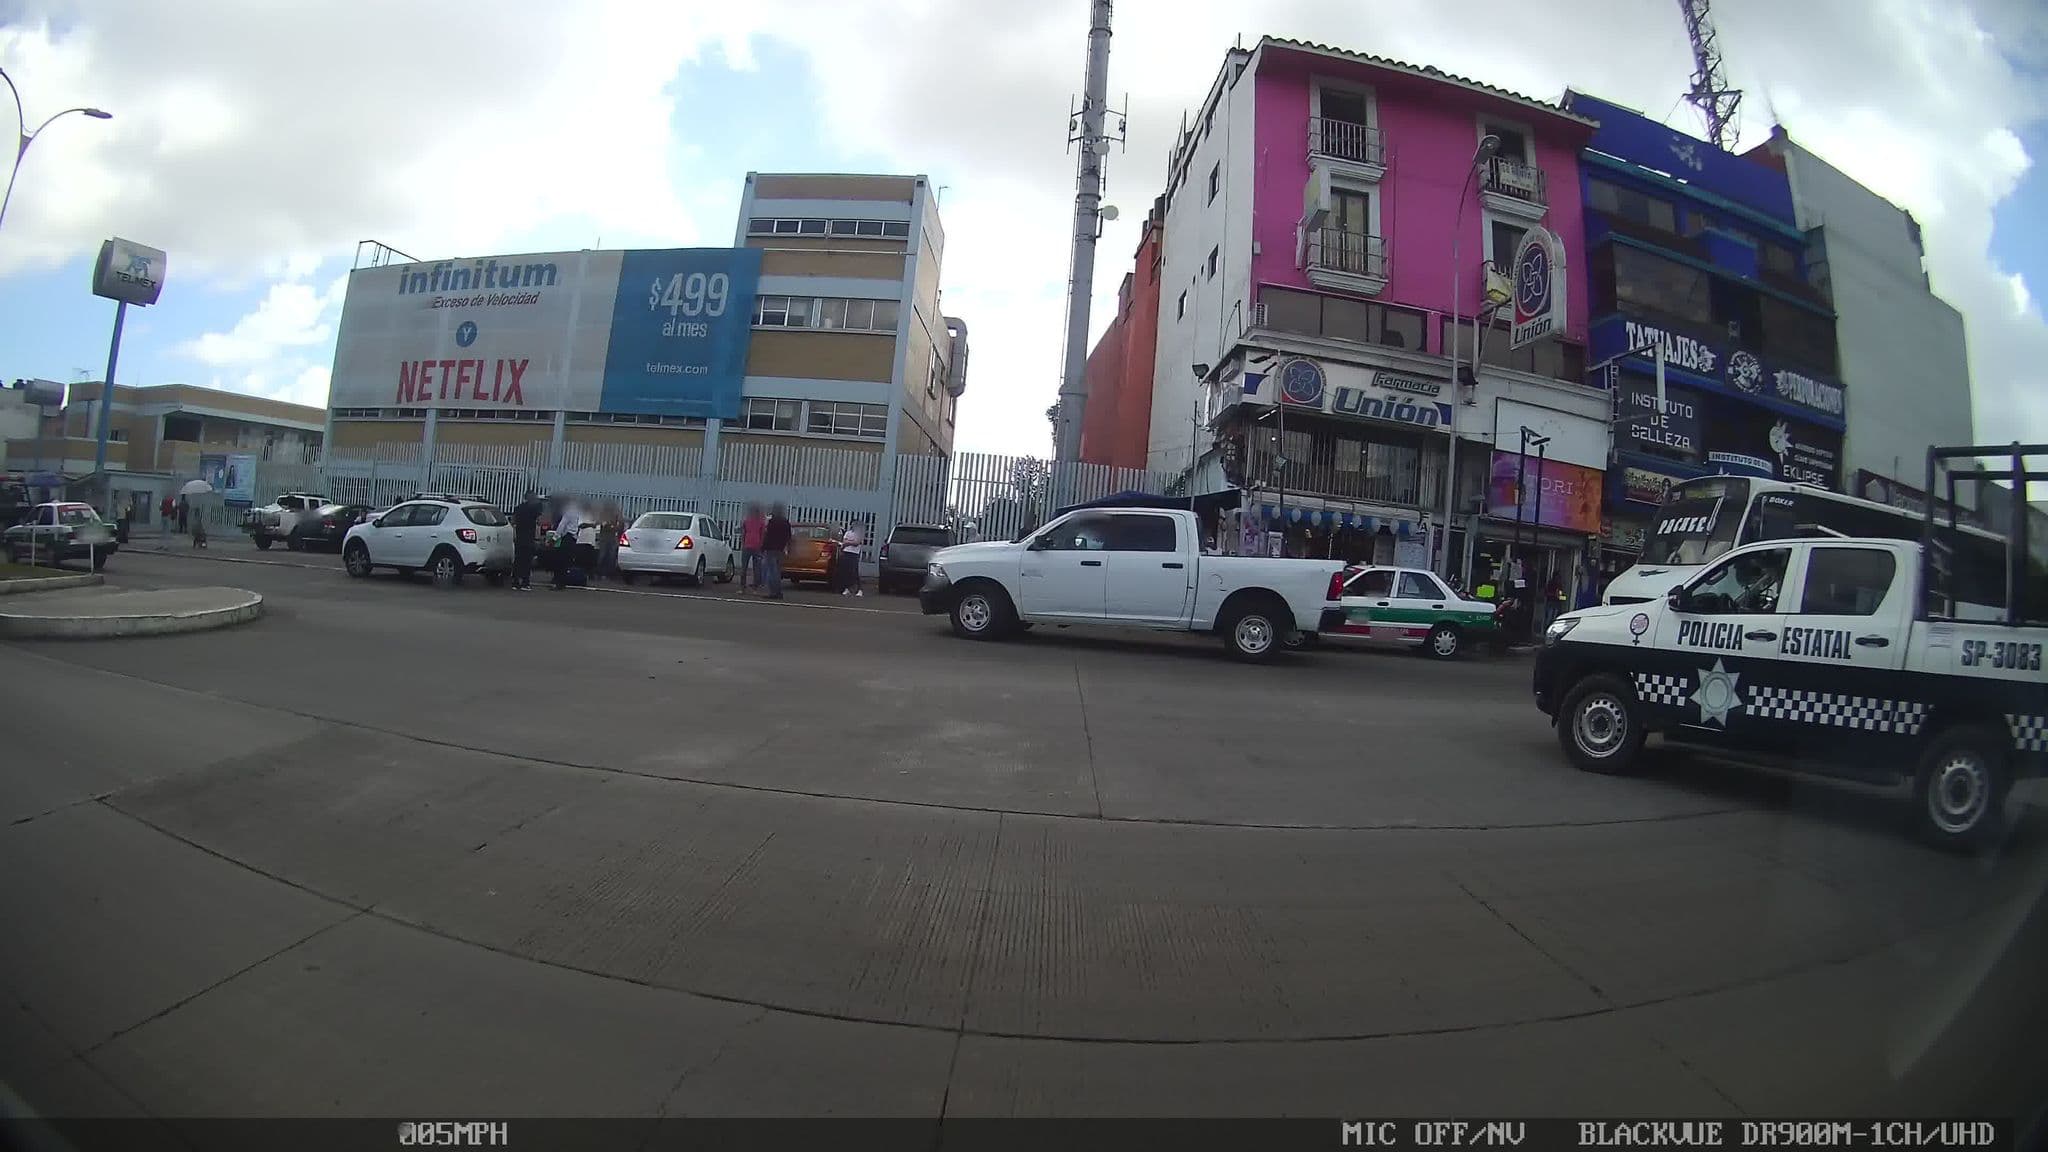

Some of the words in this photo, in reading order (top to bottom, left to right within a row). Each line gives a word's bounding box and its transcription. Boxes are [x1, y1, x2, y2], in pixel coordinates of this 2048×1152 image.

[116, 271, 156, 289] TELMEX
[399, 260, 558, 295] infinitum
[432, 296, 469, 309] Exceso
[470, 294, 484, 307] de
[486, 291, 540, 307] Velocidad
[649, 272, 729, 317] $499
[662, 317, 675, 337] al
[677, 322, 708, 337] mes
[397, 359, 529, 405] NETFLIX
[646, 361, 709, 376] telmex.com
[1333, 387, 1441, 430] Unión
[1631, 391, 1693, 419] INSTTUTO
[1782, 464, 1826, 486] EKLIPSE
[1677, 620, 1744, 650] POLICIA
[1781, 627, 1852, 660] ESTATAL
[1961, 639, 2042, 671] SP-3083
